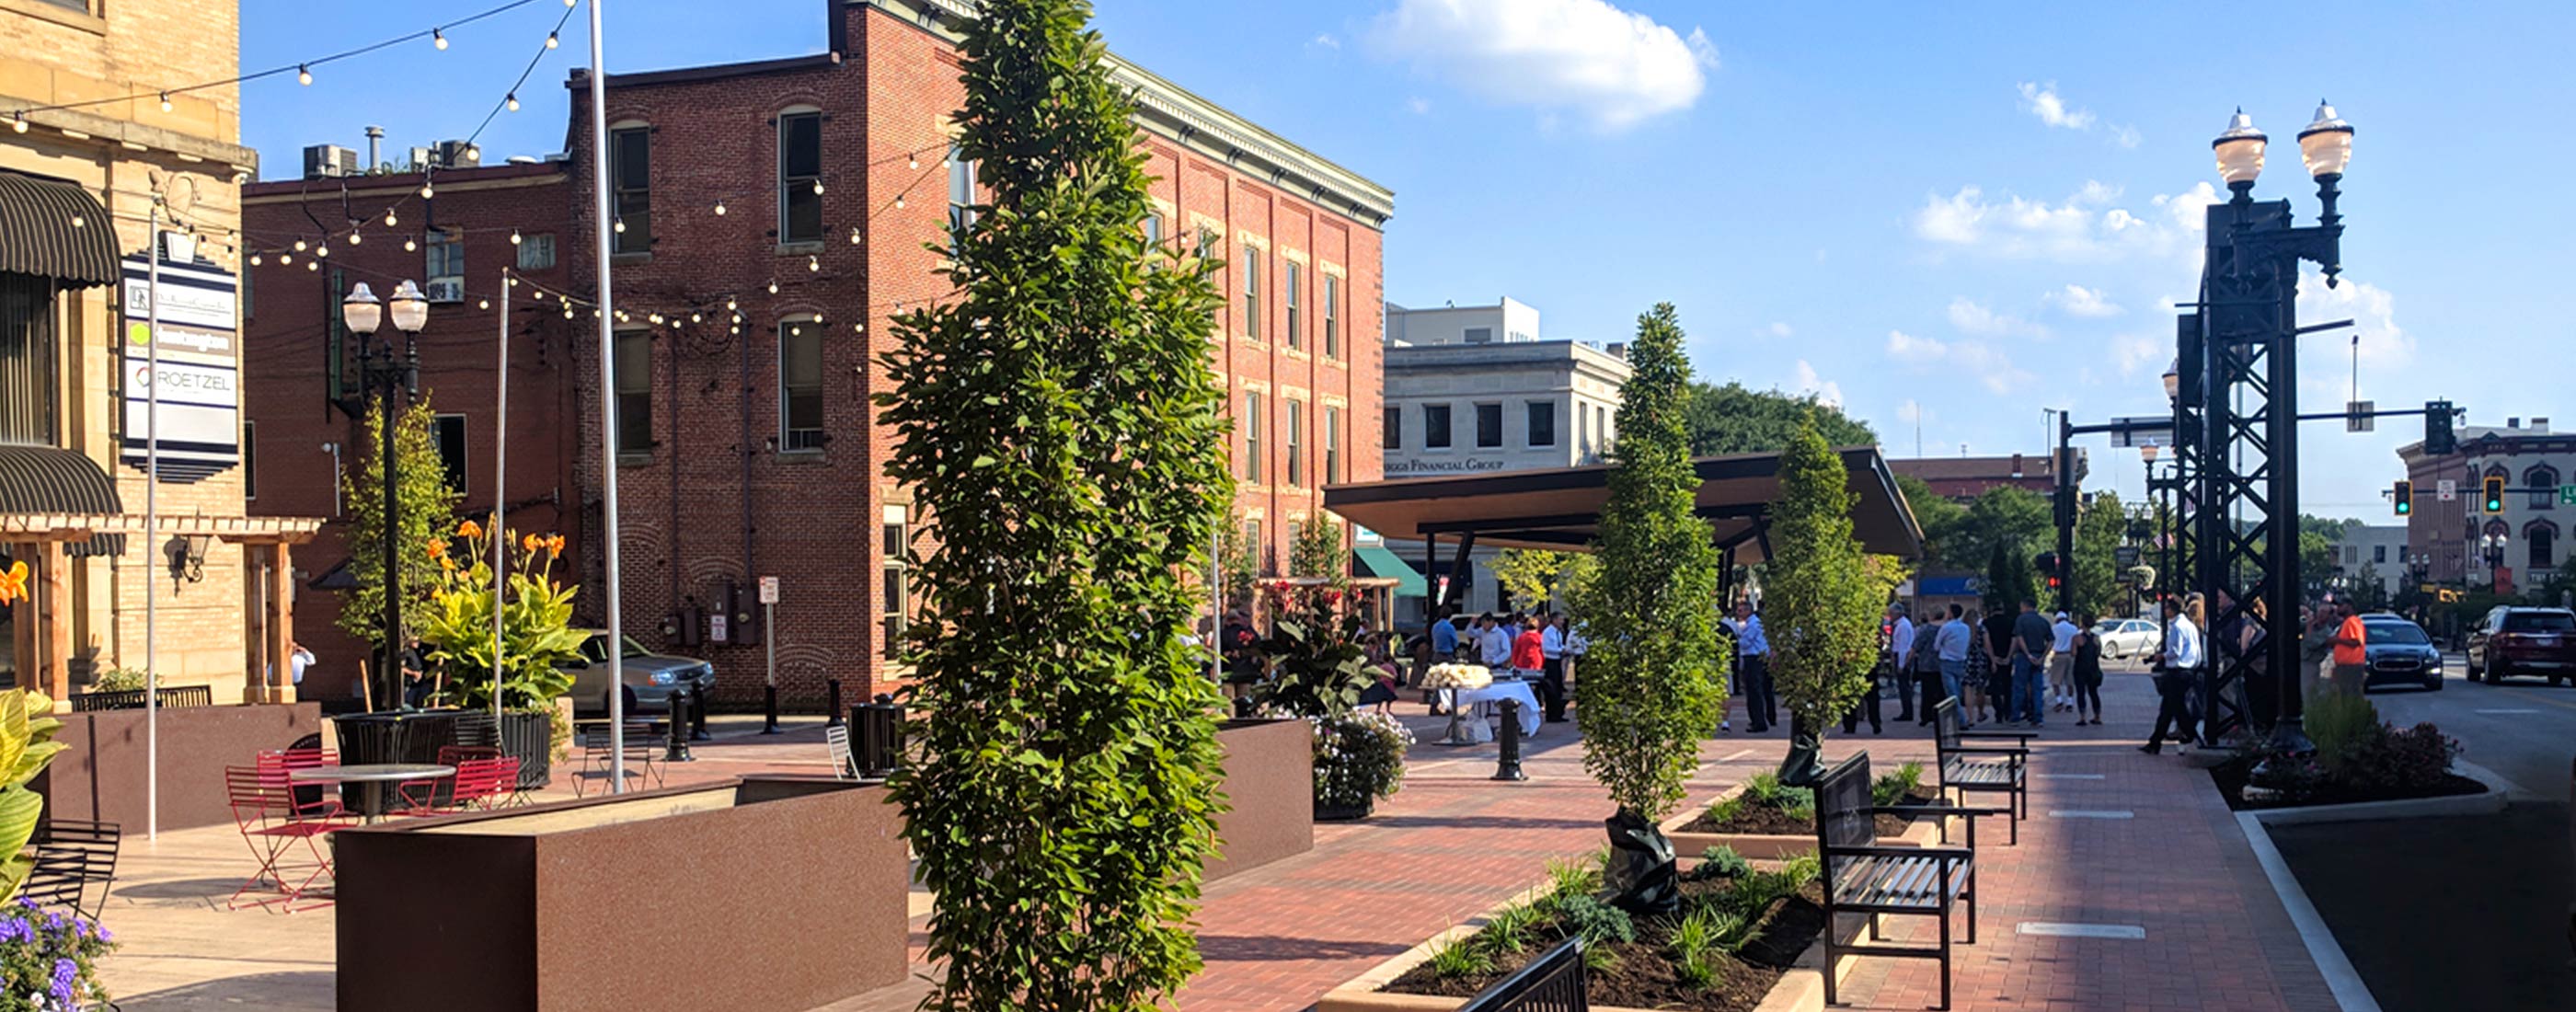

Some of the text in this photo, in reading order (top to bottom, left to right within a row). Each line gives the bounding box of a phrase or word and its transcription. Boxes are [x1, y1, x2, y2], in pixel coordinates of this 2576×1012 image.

[157, 370, 230, 391] ROETZEL
[1411, 459, 1464, 471] FINANCIAL
[1466, 457, 1504, 471] GROUP
